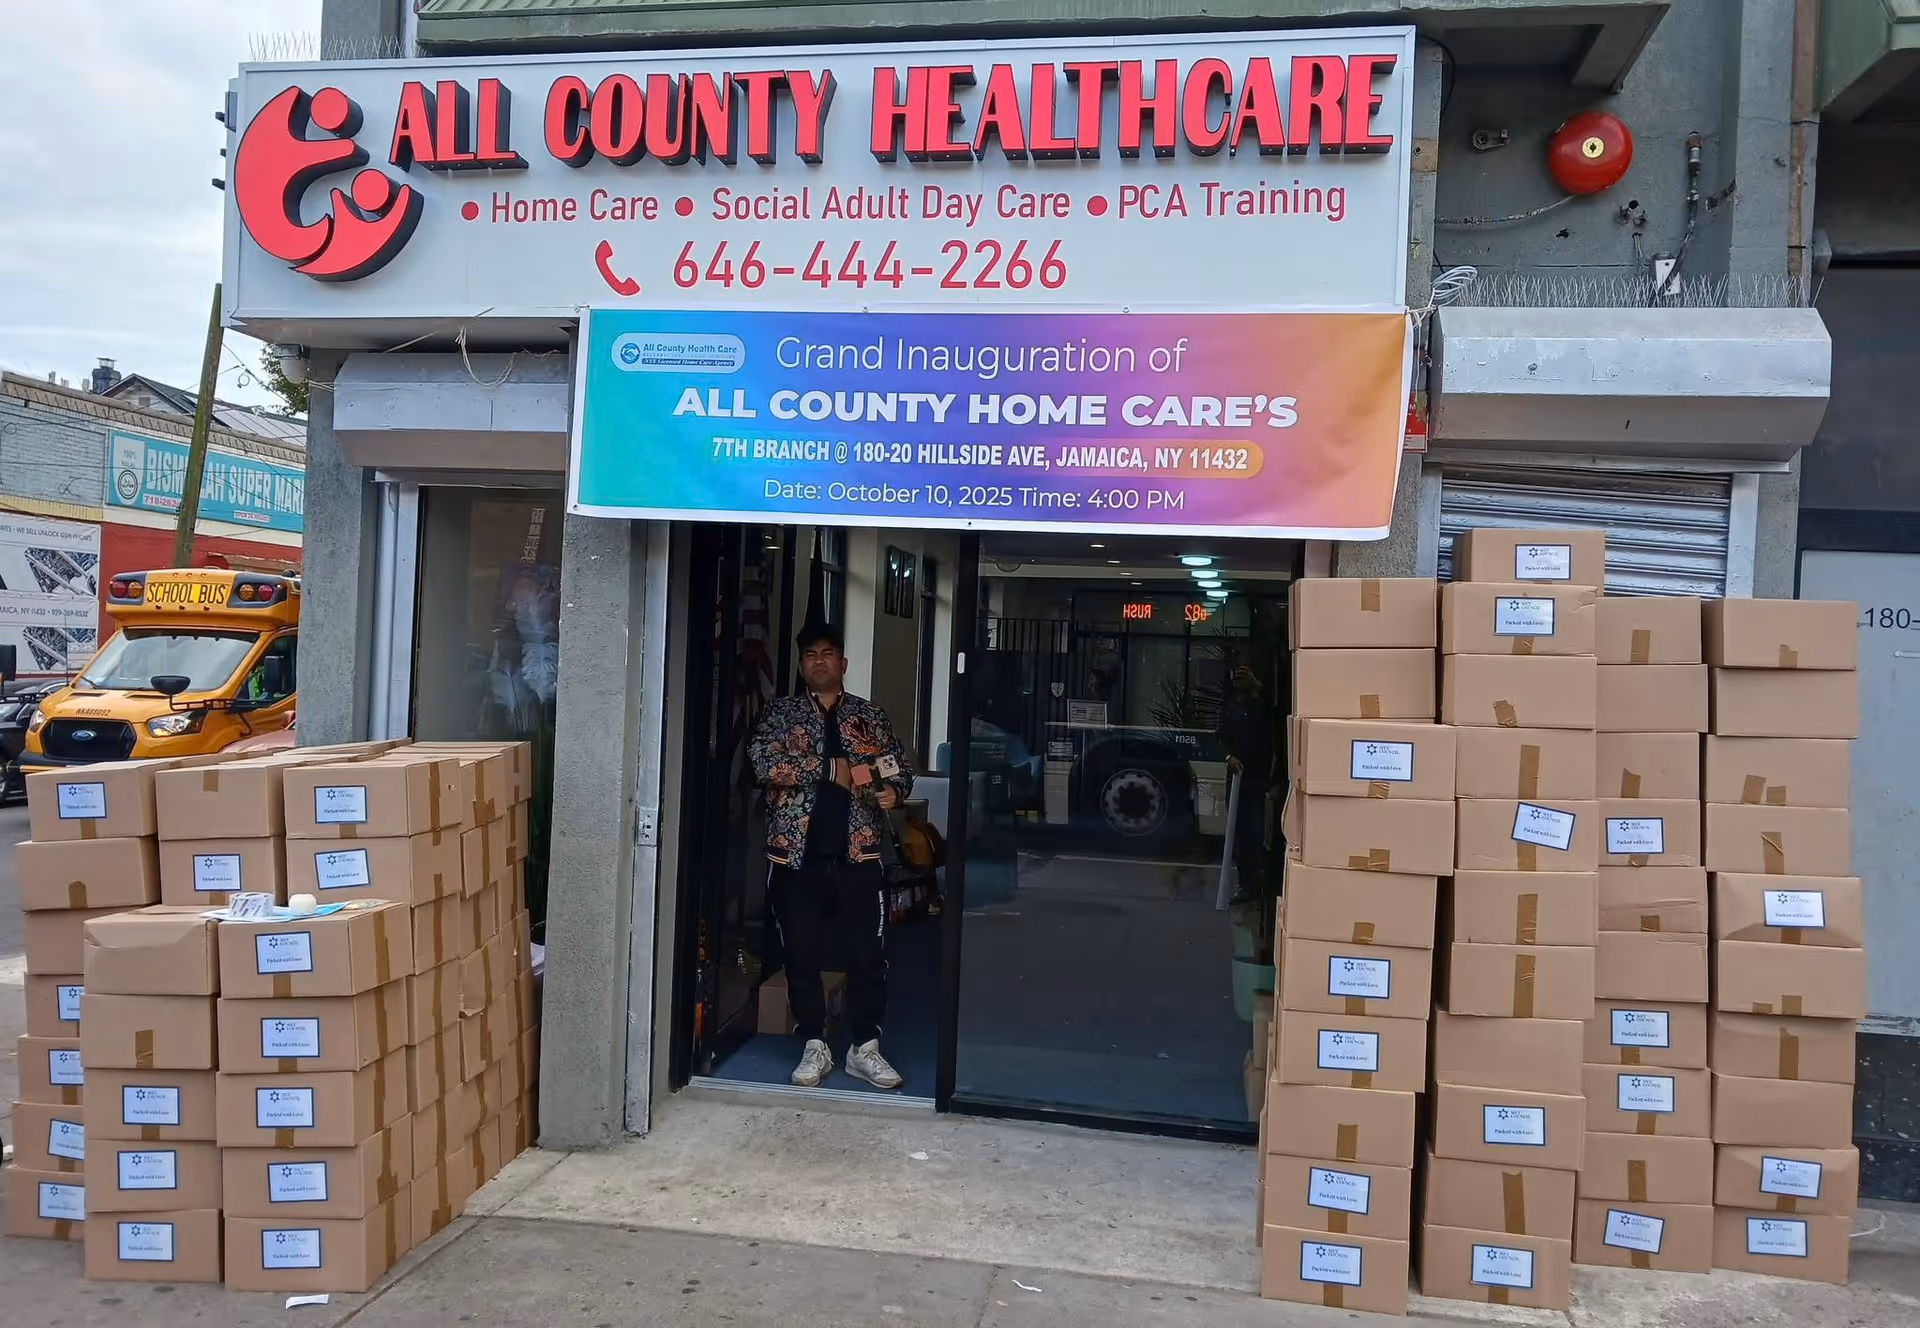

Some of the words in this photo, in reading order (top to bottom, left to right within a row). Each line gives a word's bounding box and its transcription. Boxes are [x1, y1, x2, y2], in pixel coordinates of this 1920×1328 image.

[388, 78, 526, 169] ALL
[544, 69, 838, 166] COUNTY
[870, 54, 1397, 161] HEALTHCARE
[491, 191, 577, 224] Home
[590, 188, 658, 222] Care
[712, 186, 809, 221] Social
[822, 184, 909, 220] Adult
[922, 184, 983, 227] Day
[996, 184, 1070, 218] Care
[1118, 183, 1187, 219] PCA
[1199, 180, 1345, 221] Training
[673, 239, 1067, 290] 646-444-2266
[657, 344, 685, 354] County
[688, 345, 715, 353] Health
[776, 335, 884, 371] Grand
[897, 338, 1135, 381] Inauguration
[1148, 338, 1188, 373] of
[673, 387, 756, 418] ALL
[769, 390, 955, 424] COUNTY
[968, 393, 1107, 425] HOME
[1121, 394, 1298, 428] CARE'S
[712, 437, 747, 459] 7TH
[753, 439, 829, 462] BRANCH
[834, 442, 847, 464] @
[854, 441, 912, 464] 180-20
[918, 443, 1001, 466] HILLSIDE
[1007, 446, 1050, 471] AVE,
[1056, 446, 1148, 472] JAMAICA,
[1155, 448, 1182, 469] NY
[1189, 448, 1248, 470] 11432
[146, 449, 225, 502] BISMAH
[228, 464, 272, 509] SUPER
[764, 479, 822, 500] Date:
[827, 482, 919, 504] October
[925, 485, 953, 509] 10,
[958, 486, 1012, 507] 2025
[1018, 487, 1081, 509] Time:
[1087, 488, 1140, 510] 4:00
[1147, 490, 1185, 511] PM
[146, 583, 194, 603] SCHOOL
[198, 584, 226, 605] BUS
